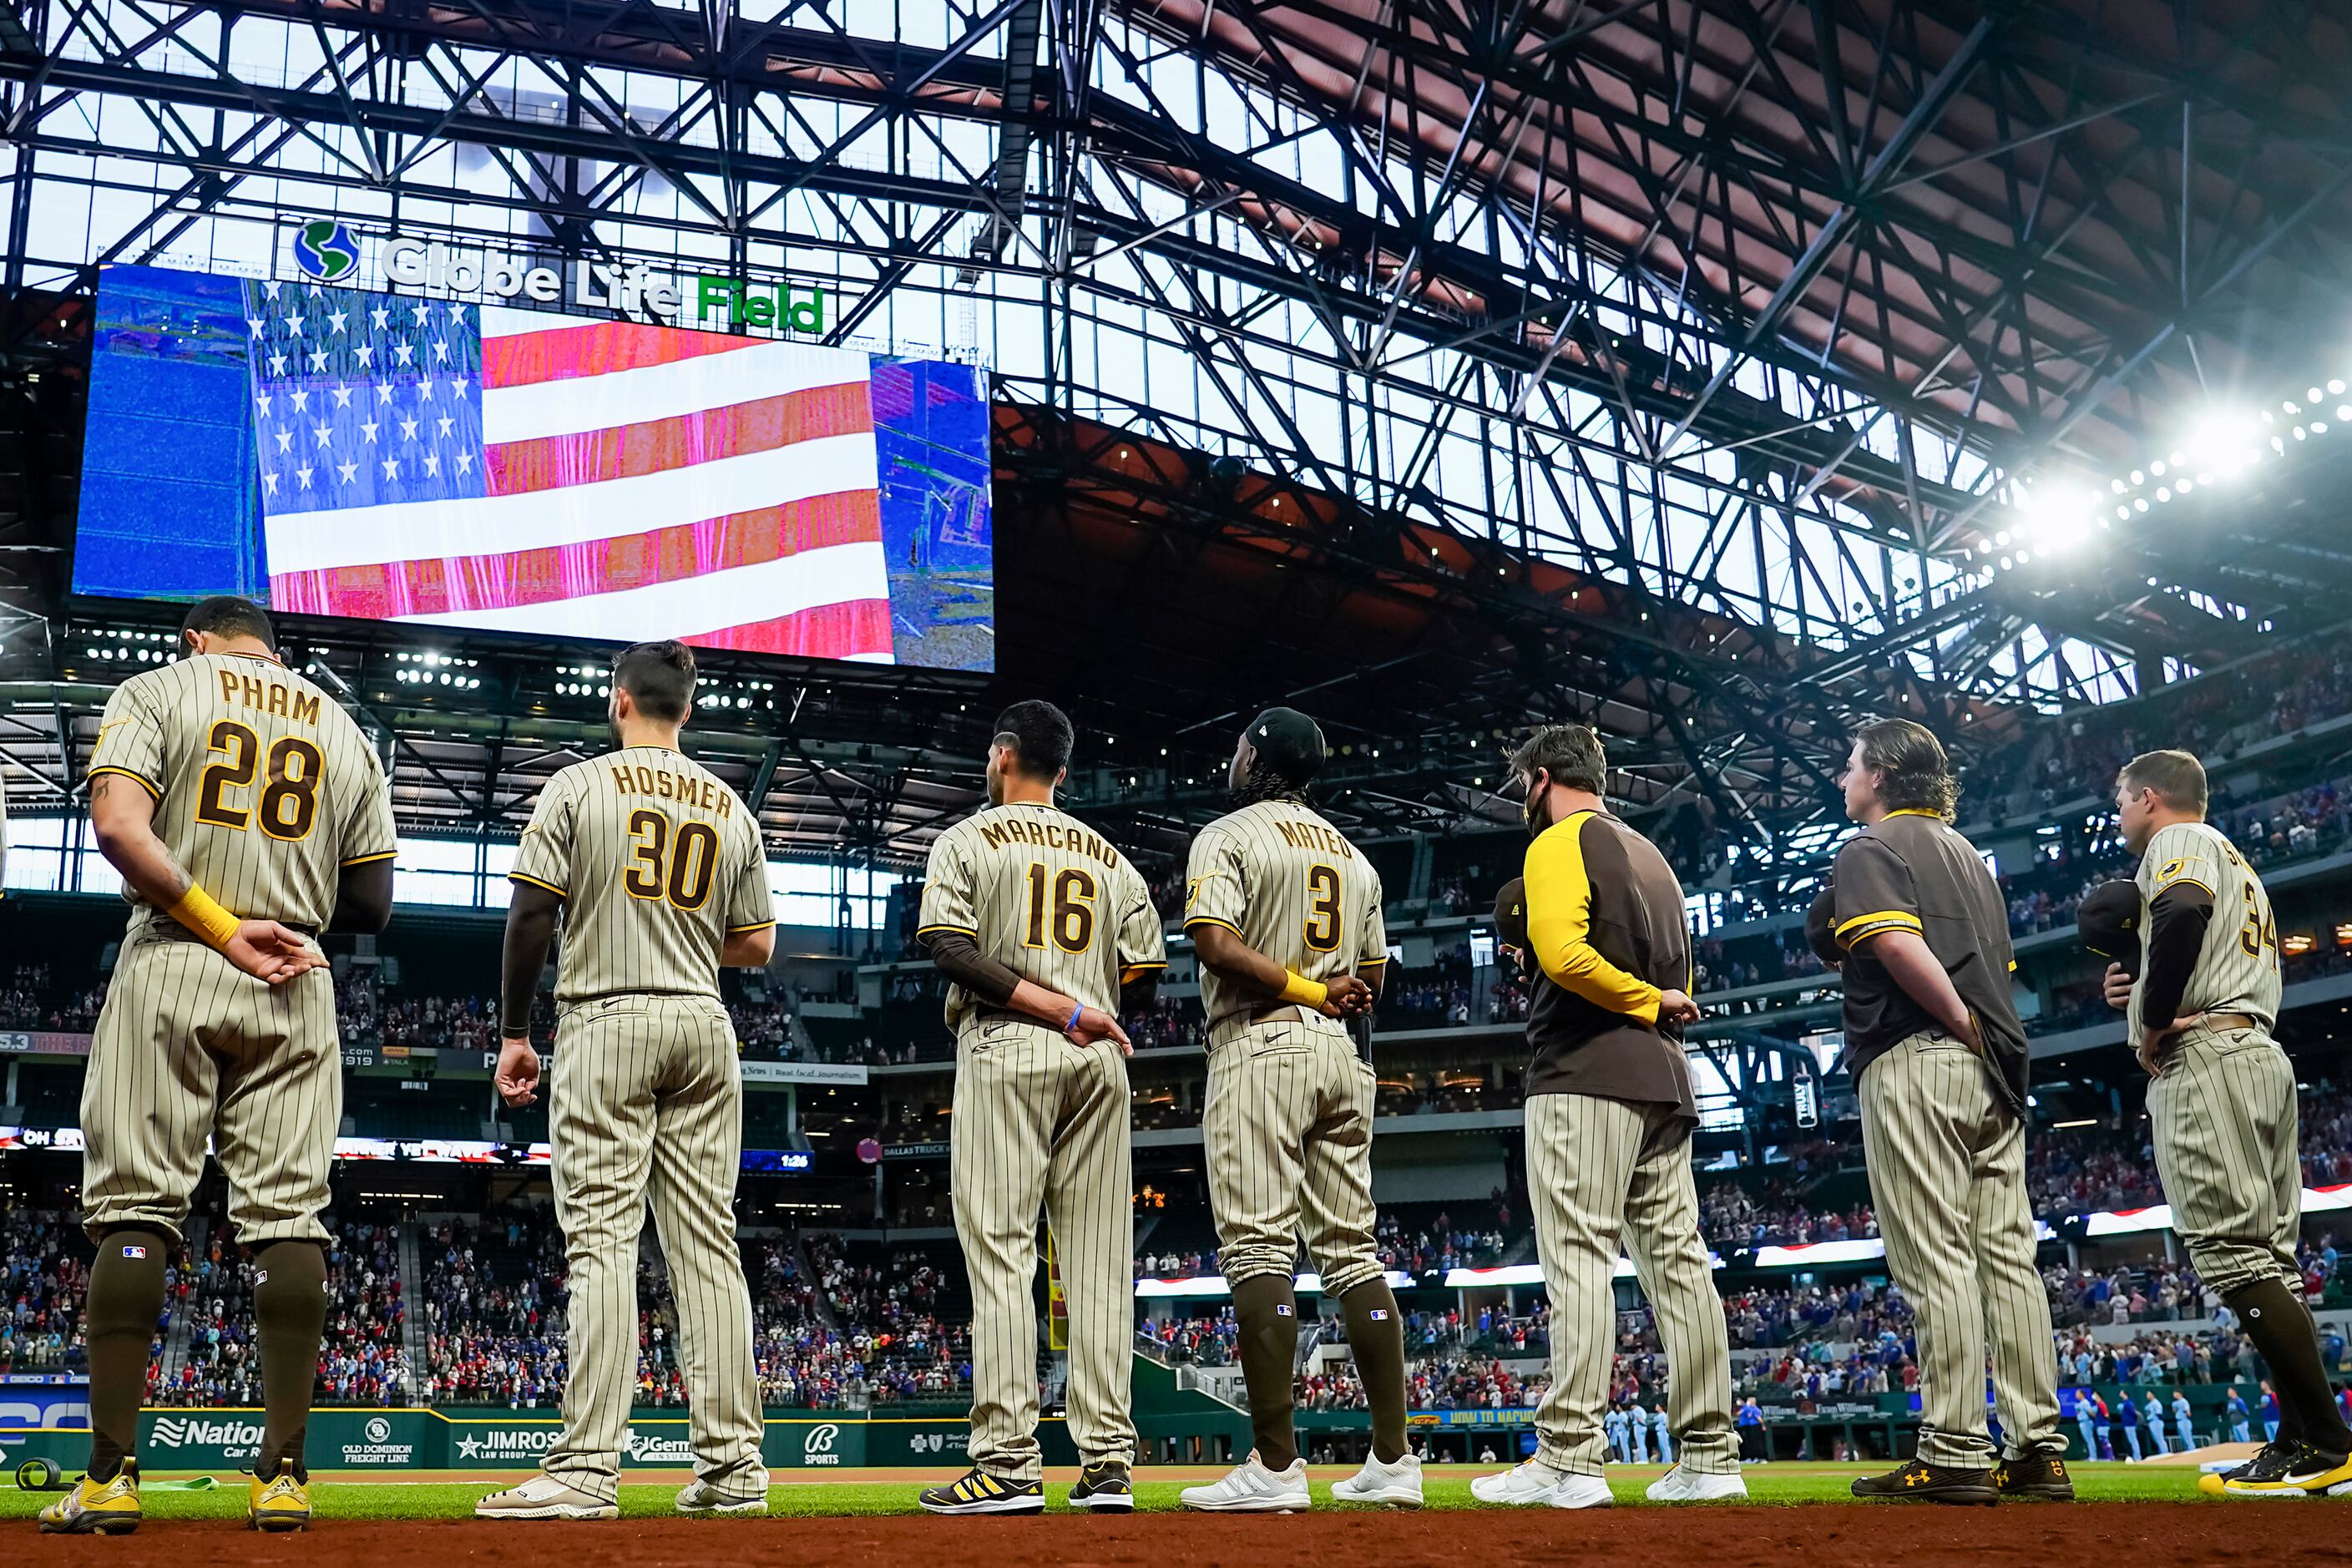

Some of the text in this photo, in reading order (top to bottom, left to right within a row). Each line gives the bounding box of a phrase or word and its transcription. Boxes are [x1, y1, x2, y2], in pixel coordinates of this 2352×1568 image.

[382, 238, 824, 334] Globe Life Field
[219, 670, 321, 727] PHAM
[195, 718, 324, 842] 28
[611, 765, 732, 821] HOSMER
[624, 807, 720, 912] 30
[980, 819, 1119, 870] MARCANO
[1274, 820, 1353, 860] MATEO
[1023, 861, 1097, 954] 16
[1303, 863, 1343, 953] 3
[1794, 1083, 1808, 1120] TRULY
[23, 1130, 50, 1146] OH
[883, 1147, 913, 1156] DALLAS
[914, 1144, 944, 1155] TRUCK
[223, 1446, 247, 1458] Car
[342, 1444, 412, 1454] OLD DOMINION
[345, 1454, 409, 1463] FREIGHT LINE
[499, 1451, 526, 1459] GROUP
[805, 1454, 839, 1464] SPORTS
